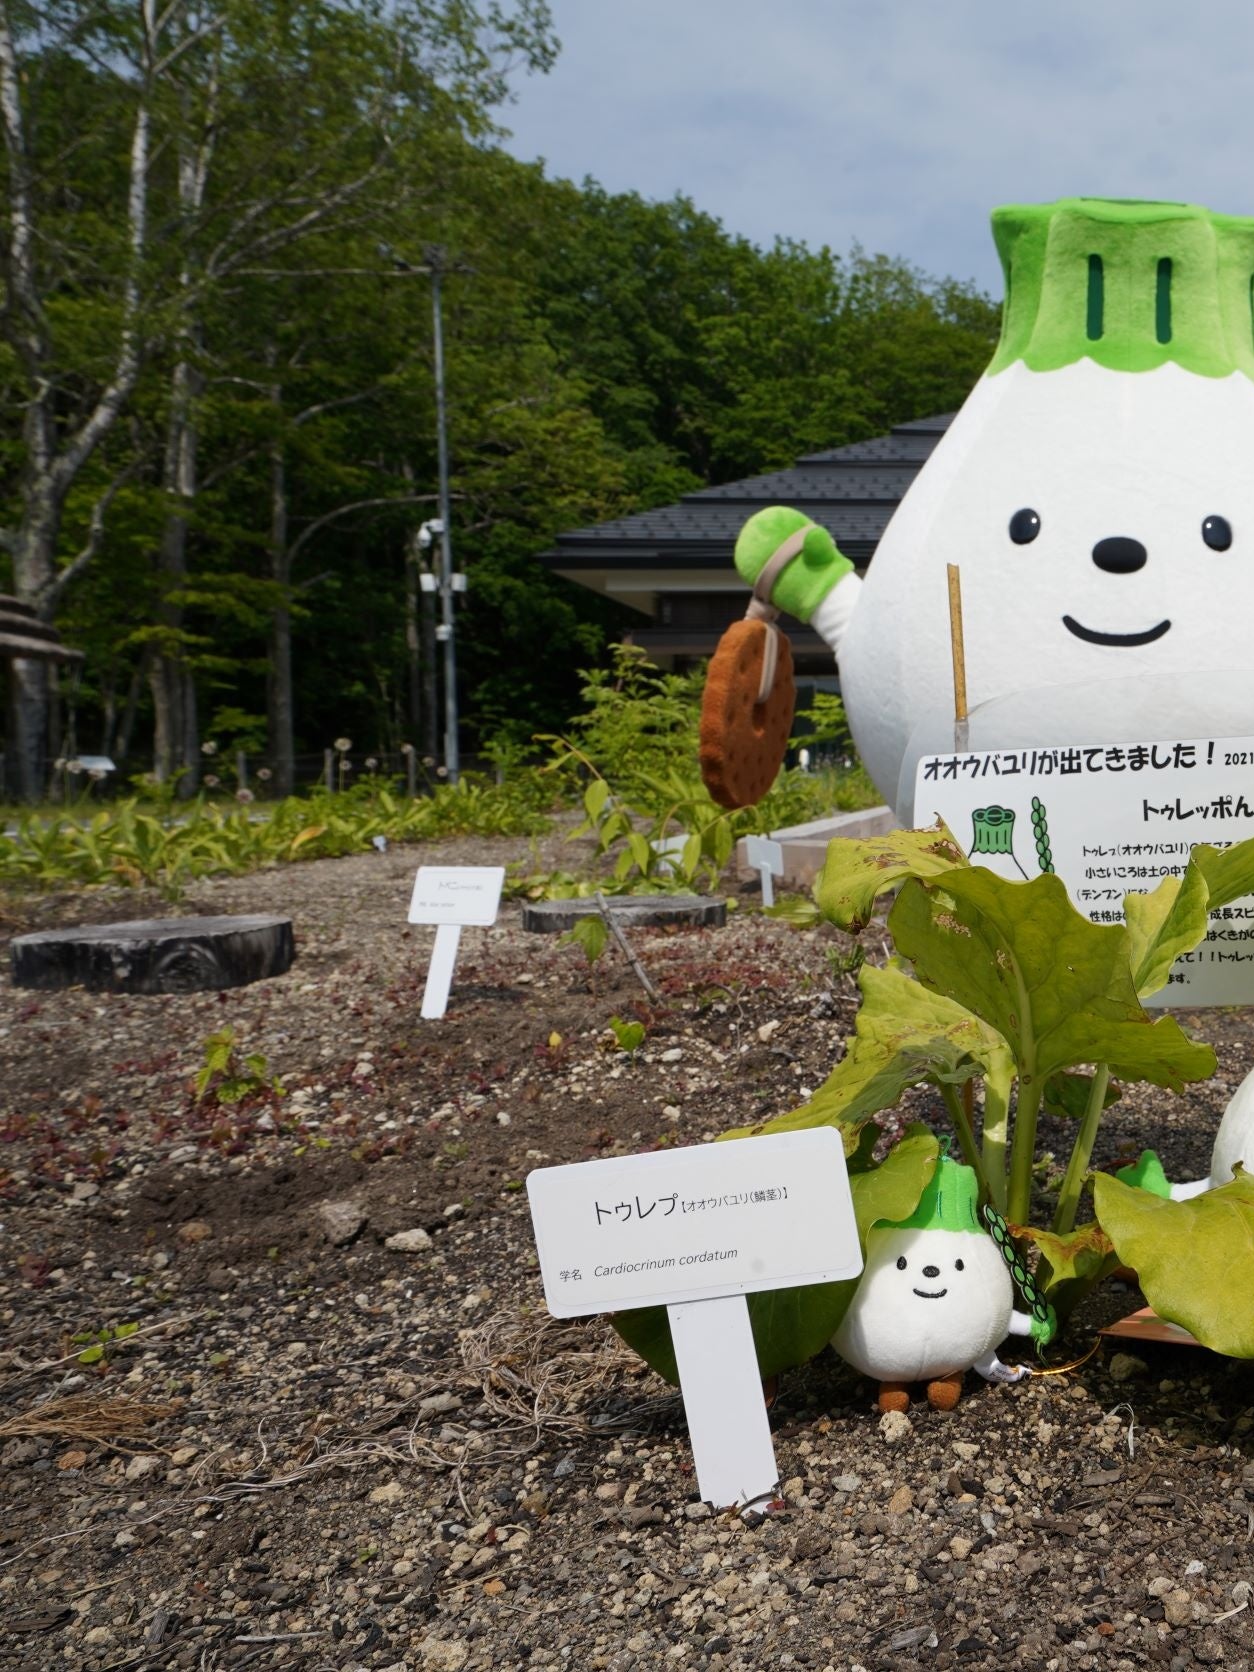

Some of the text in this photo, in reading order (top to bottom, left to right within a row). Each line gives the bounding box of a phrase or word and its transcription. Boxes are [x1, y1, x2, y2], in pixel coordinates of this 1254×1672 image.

[924, 741, 1215, 781] オオウバユリが出てきました！
[1143, 795, 1254, 821] トゥレッポん
[559, 1248, 738, 1282] 学名 Cardiocrinum cordatum
